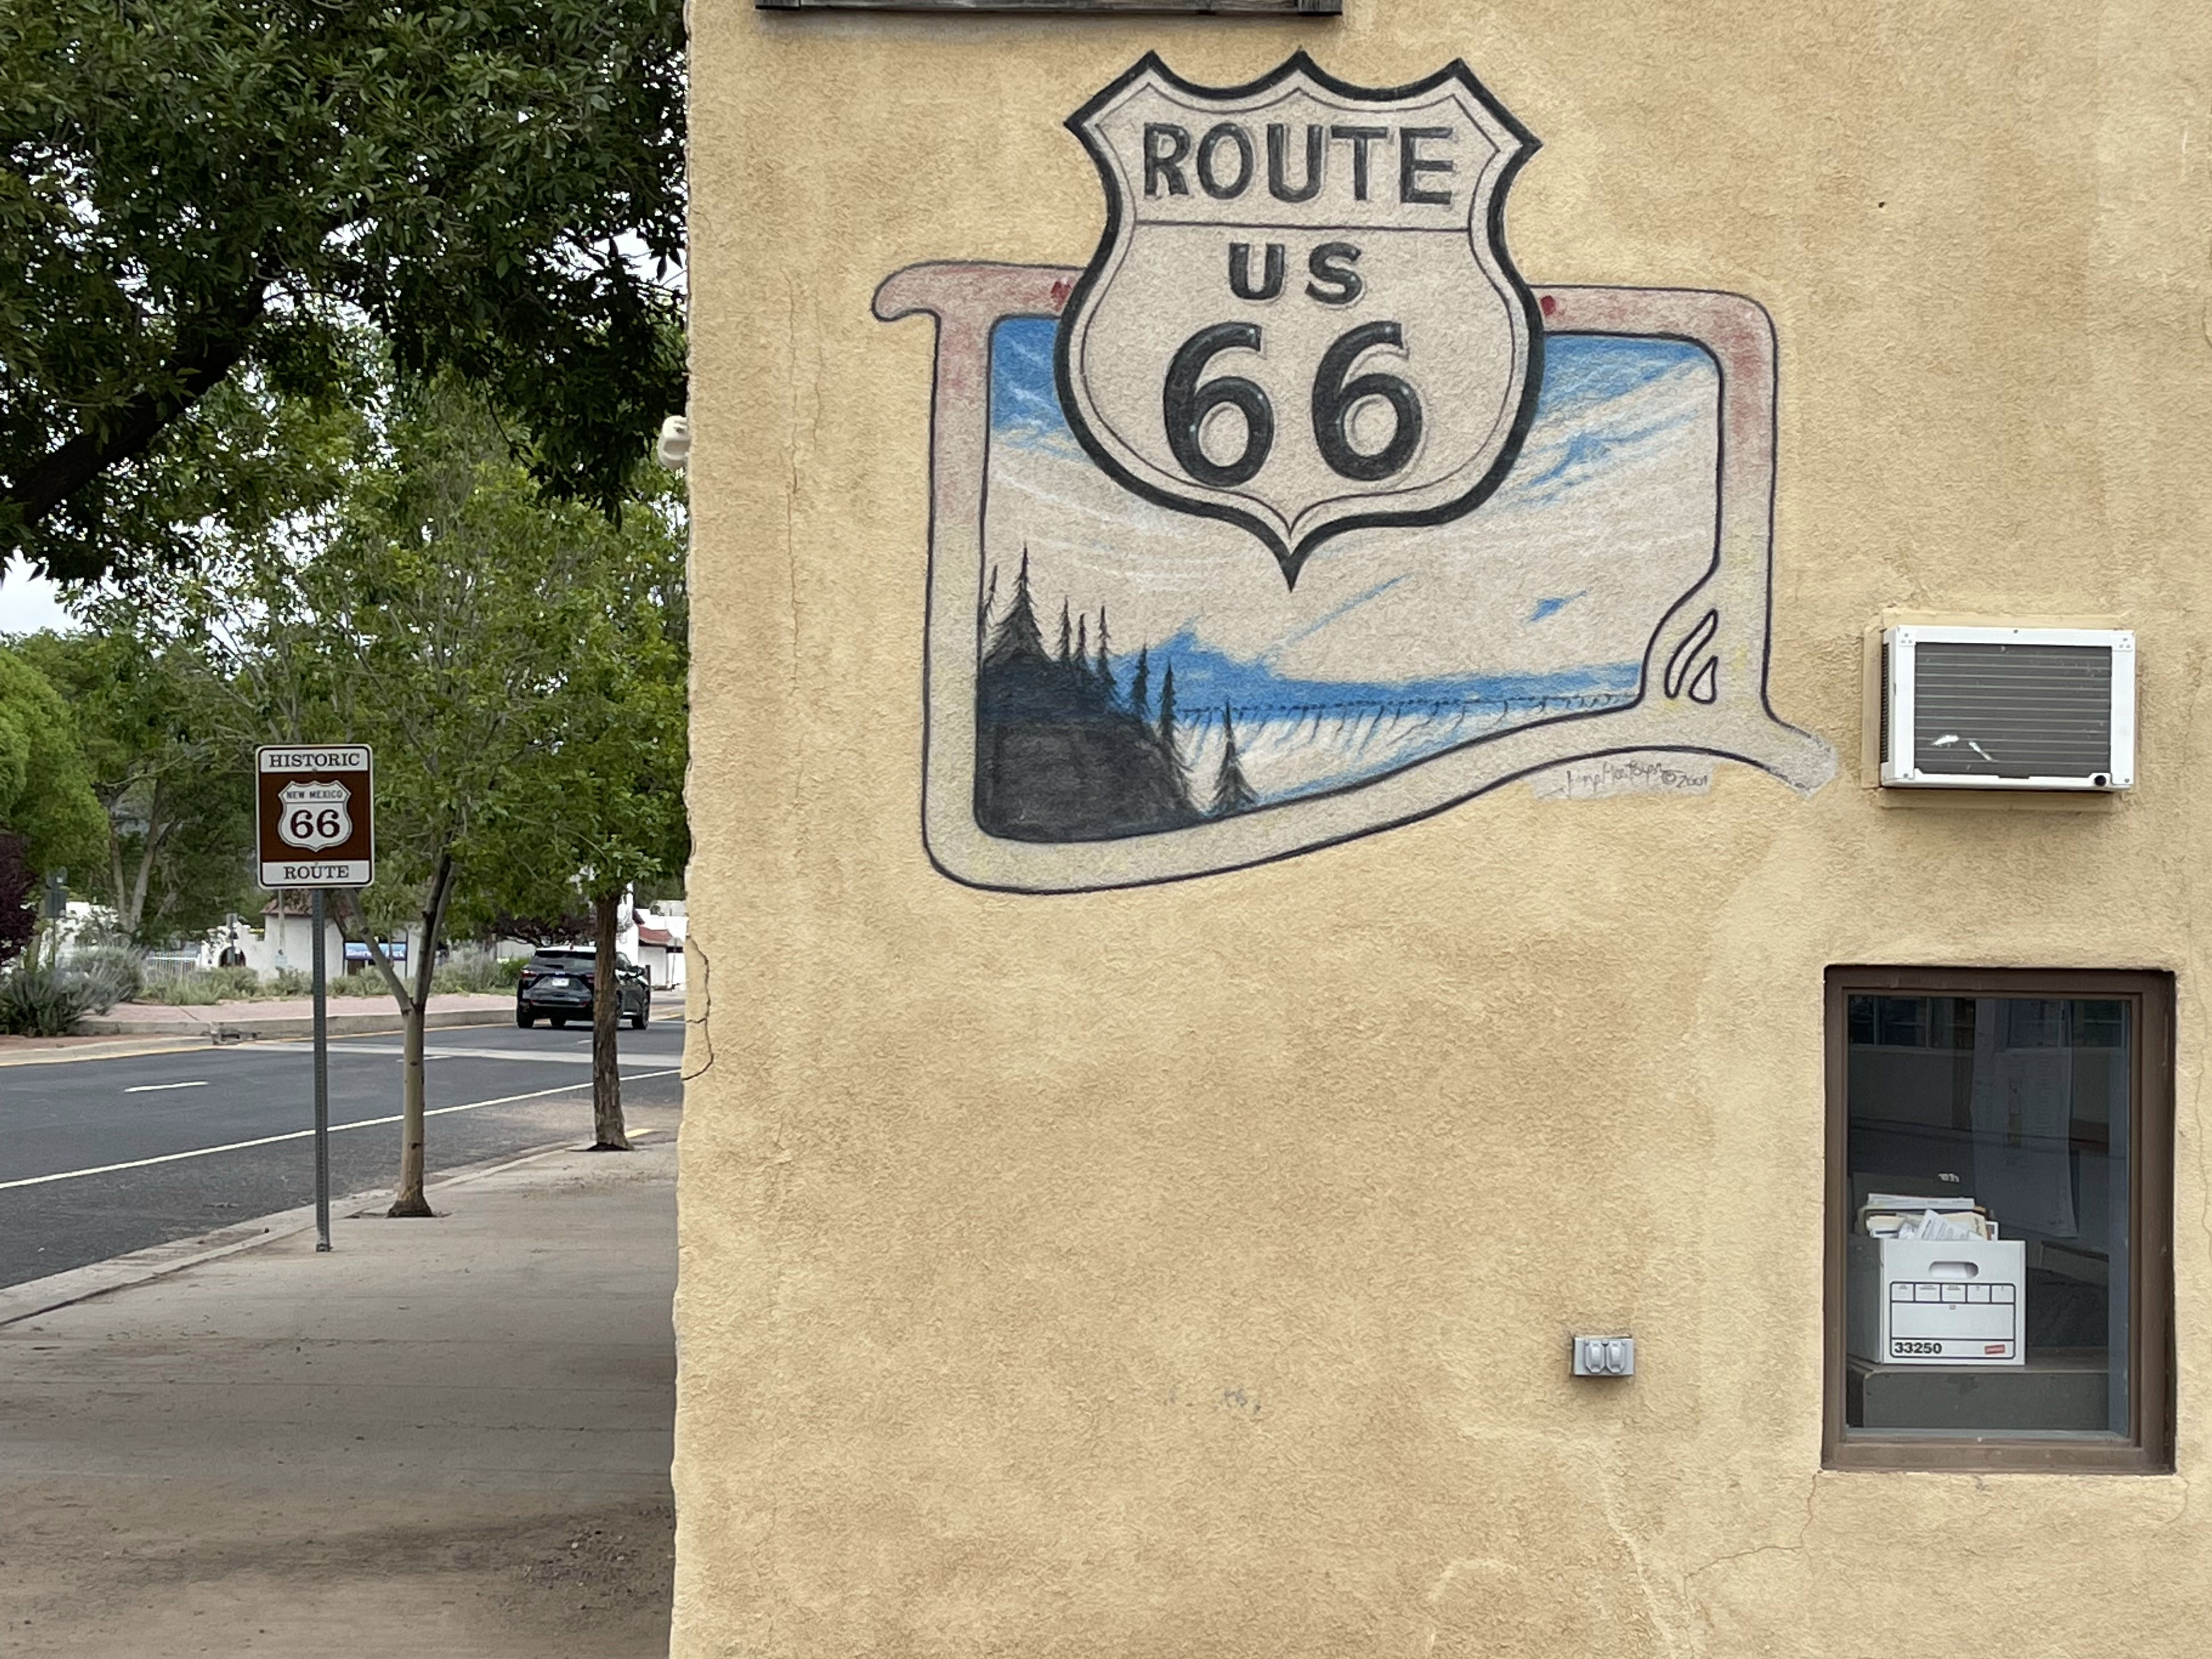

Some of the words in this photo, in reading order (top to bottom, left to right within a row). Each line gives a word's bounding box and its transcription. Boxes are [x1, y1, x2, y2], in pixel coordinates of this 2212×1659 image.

[1143, 122, 1456, 205] ROUTE
[1228, 241, 1364, 305] US
[1163, 321, 1423, 487] 66
[269, 753, 360, 767] HISTORIC
[310, 790, 343, 798] MEXICO
[290, 809, 340, 839] 66
[283, 865, 349, 879] ROUTE
[1894, 1342, 1942, 1354] 33250
